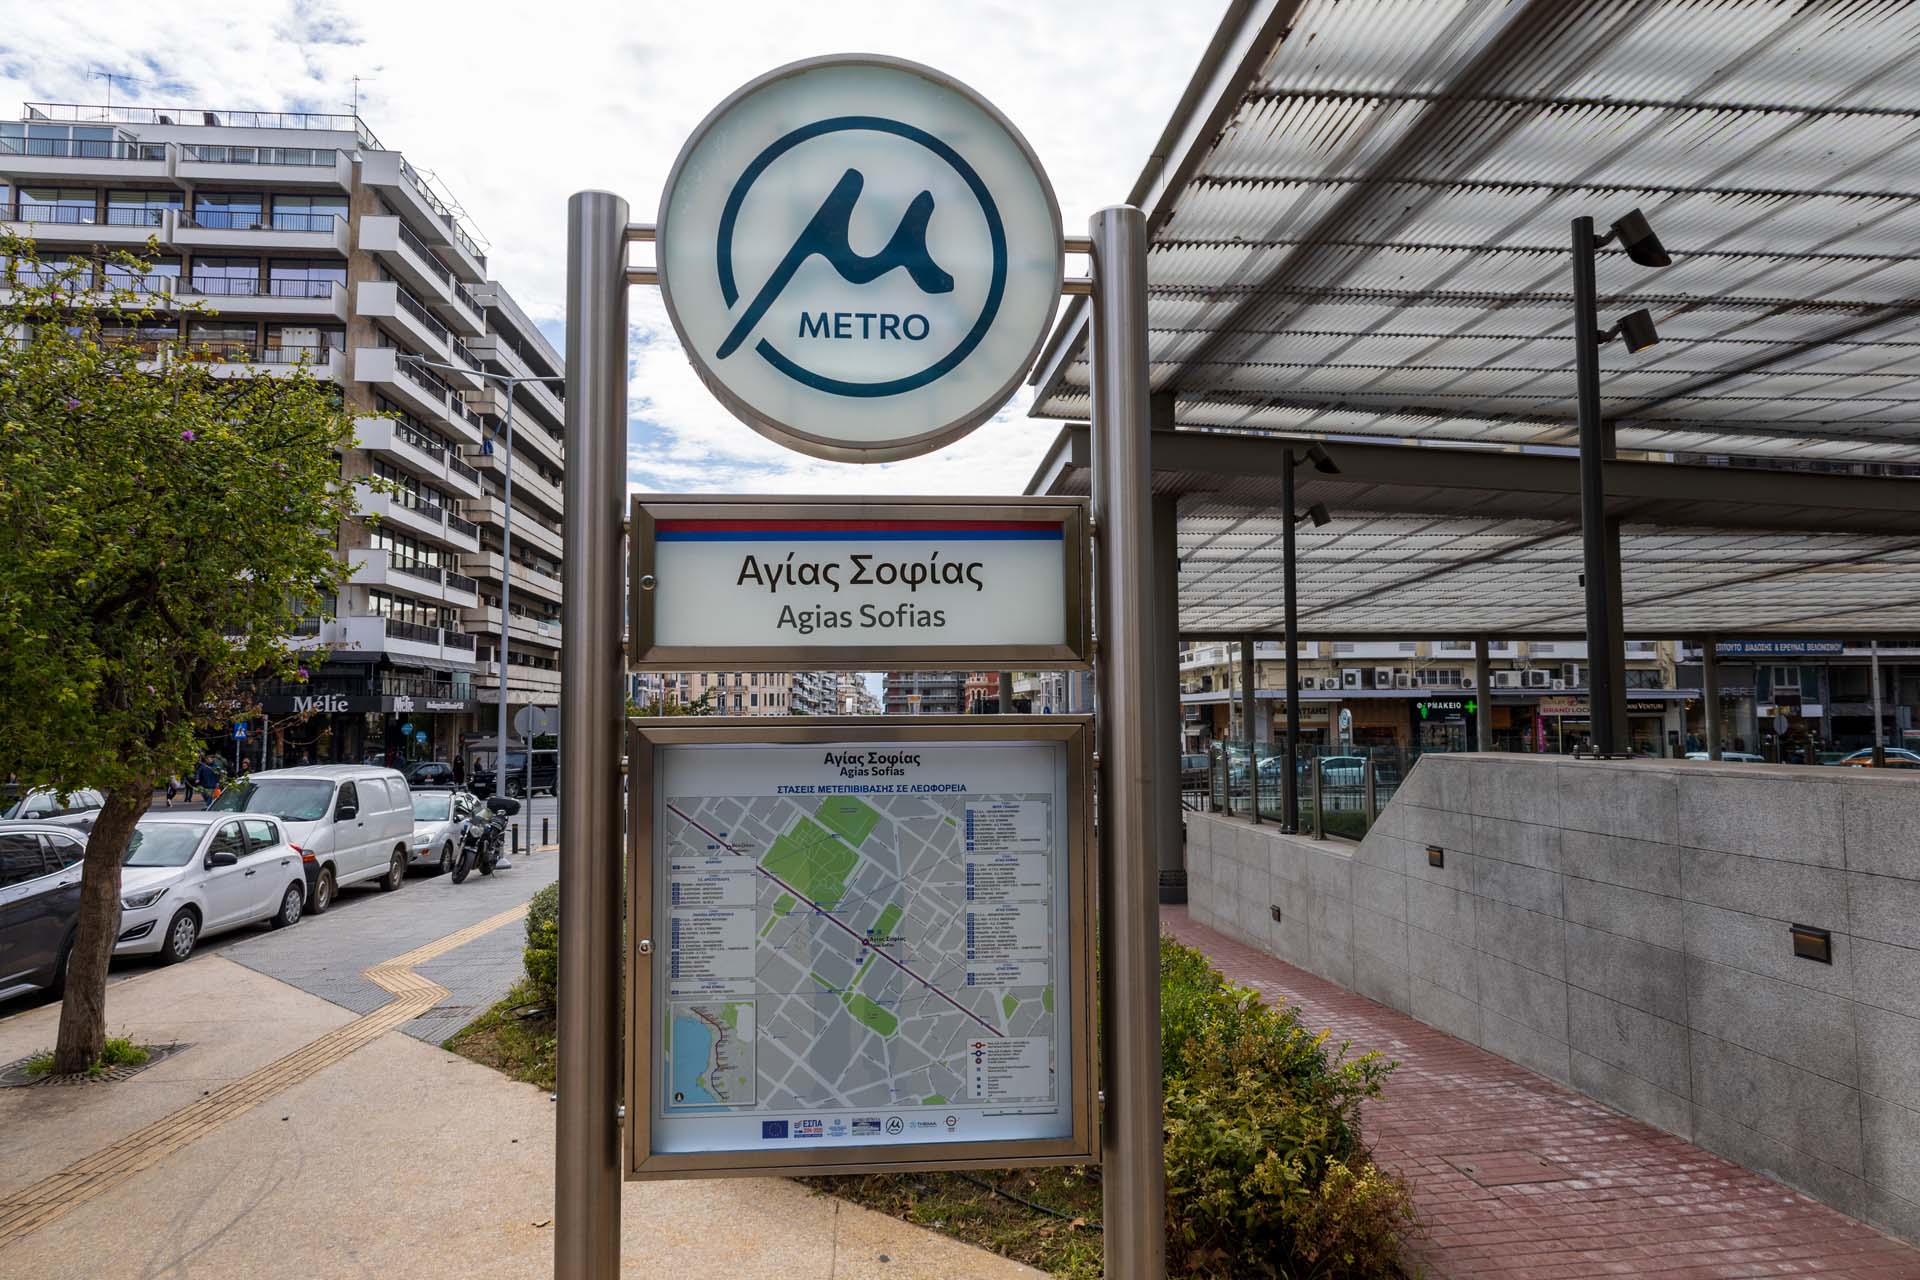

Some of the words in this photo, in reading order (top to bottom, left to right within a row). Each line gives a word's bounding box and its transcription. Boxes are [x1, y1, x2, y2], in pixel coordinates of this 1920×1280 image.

[798, 311, 930, 341] METRO
[736, 552, 840, 593] Αγίας
[849, 551, 984, 592] Σοφίας
[777, 603, 853, 635] Agias
[859, 602, 946, 630] Sofias
[293, 694, 349, 713] Mélie
[1416, 702, 1462, 710] ΦΡΜΑΚΕΙΟ
[824, 751, 865, 767] Αγίας
[867, 751, 921, 767] Σοφίας
[839, 766, 870, 778] Agias
[871, 766, 905, 777] Sofias
[777, 784, 816, 794] ΣΤΑΣΕΙΣ
[817, 784, 894, 794] ΜΕΤΕΠΙΒΙΒΑΣΗΣ
[896, 783, 909, 793] ΣΕ
[910, 783, 967, 793] ΛΕΩΦΟΡΕΙΑ
[803, 1119, 823, 1128] ΕΣΠΑ
